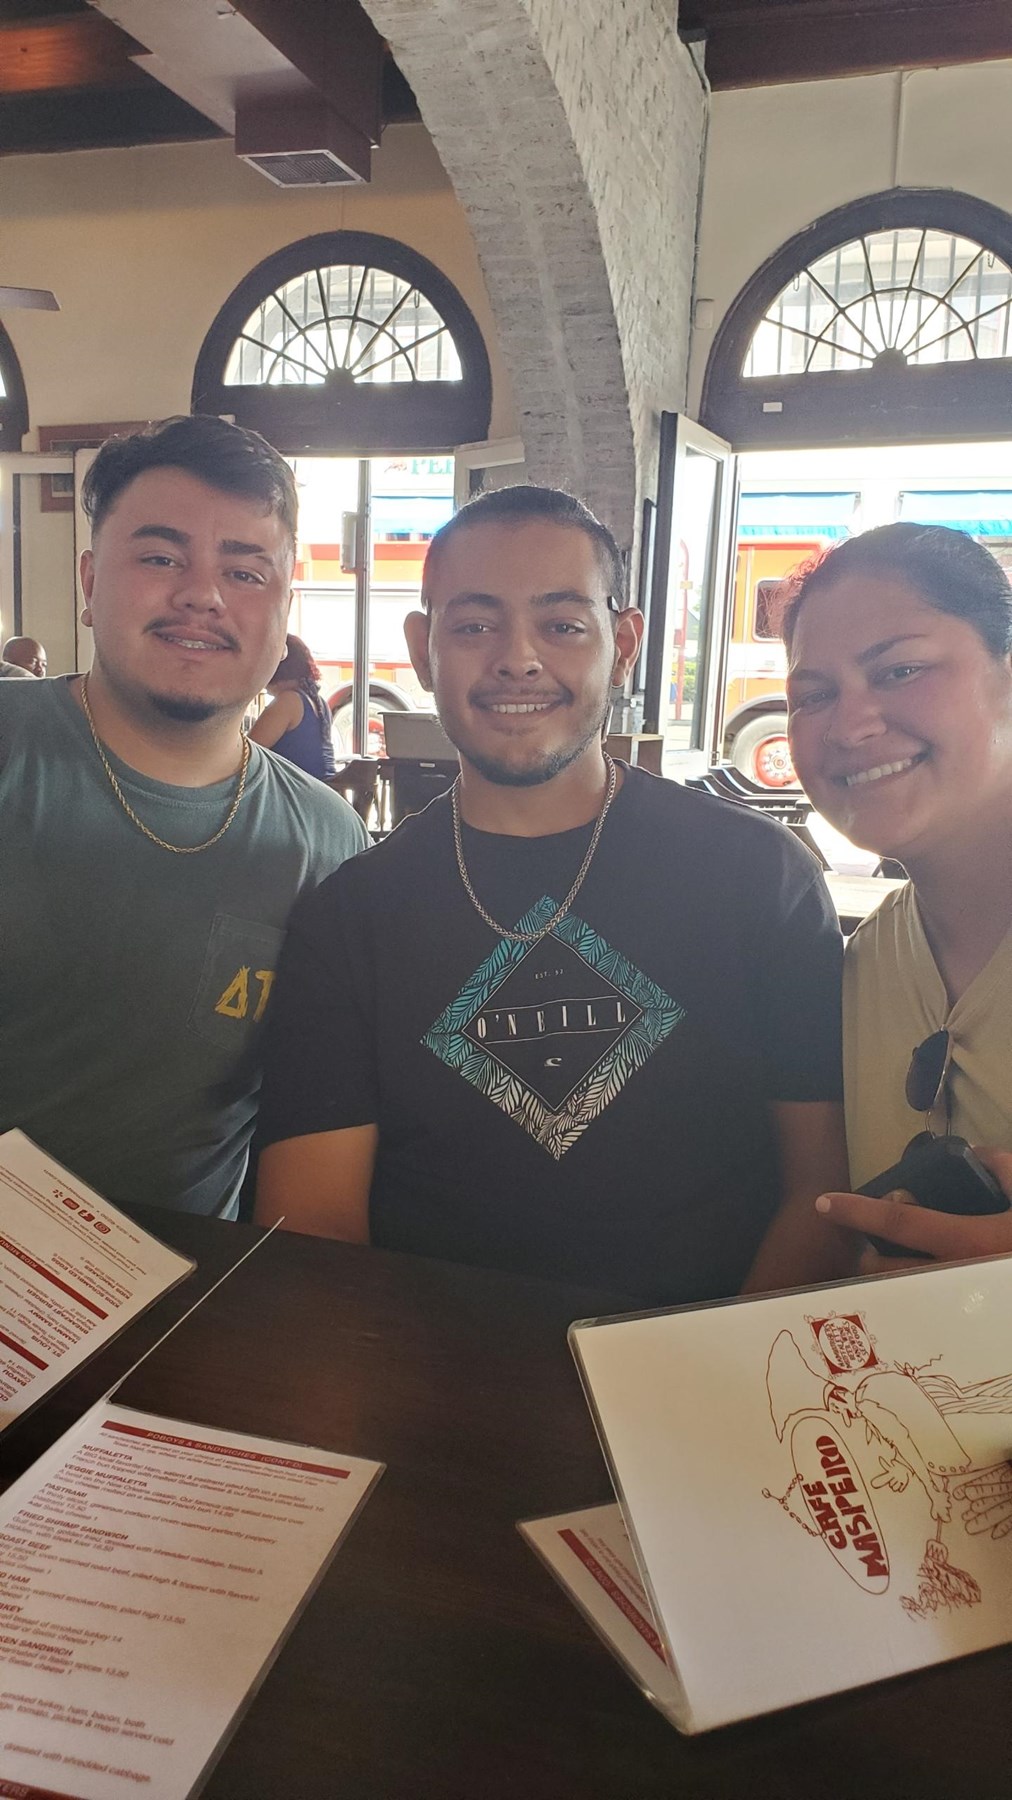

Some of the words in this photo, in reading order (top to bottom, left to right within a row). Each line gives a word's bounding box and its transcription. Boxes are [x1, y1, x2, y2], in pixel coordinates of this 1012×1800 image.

[477, 1001, 626, 1039] O'NEILL
[19, 1254, 38, 1267] KIDS
[83, 1265, 115, 1288] PANCAKES
[26, 1288, 53, 1308] BURGER
[104, 1296, 119, 1307] KIDS
[115, 1288, 130, 1298] KIDS
[27, 1308, 53, 1326] SAMMY
[52, 1308, 89, 1334] BREAKFAST
[30, 1335, 51, 1350] LOUIS
[52, 1325, 77, 1344] HAMMY
[2, 1368, 27, 1386] BAYOU
[81, 1443, 133, 1461] MUFFALETTA
[195, 1441, 256, 1459] SANDWICHES
[64, 1463, 94, 1474] VEGGIE
[94, 1470, 147, 1487] MUFFALETTA
[44, 1483, 87, 1497] PASTRAMI
[802, 1480, 848, 1550] CAFE
[17, 1509, 44, 1520] FRIED
[44, 1516, 80, 1529] SHRIMP
[80, 1524, 128, 1540] SANDWICH
[27, 1540, 52, 1551] BEEF
[7, 1573, 30, 1583] HAM
[18, 1639, 73, 1657] SANDWICH
